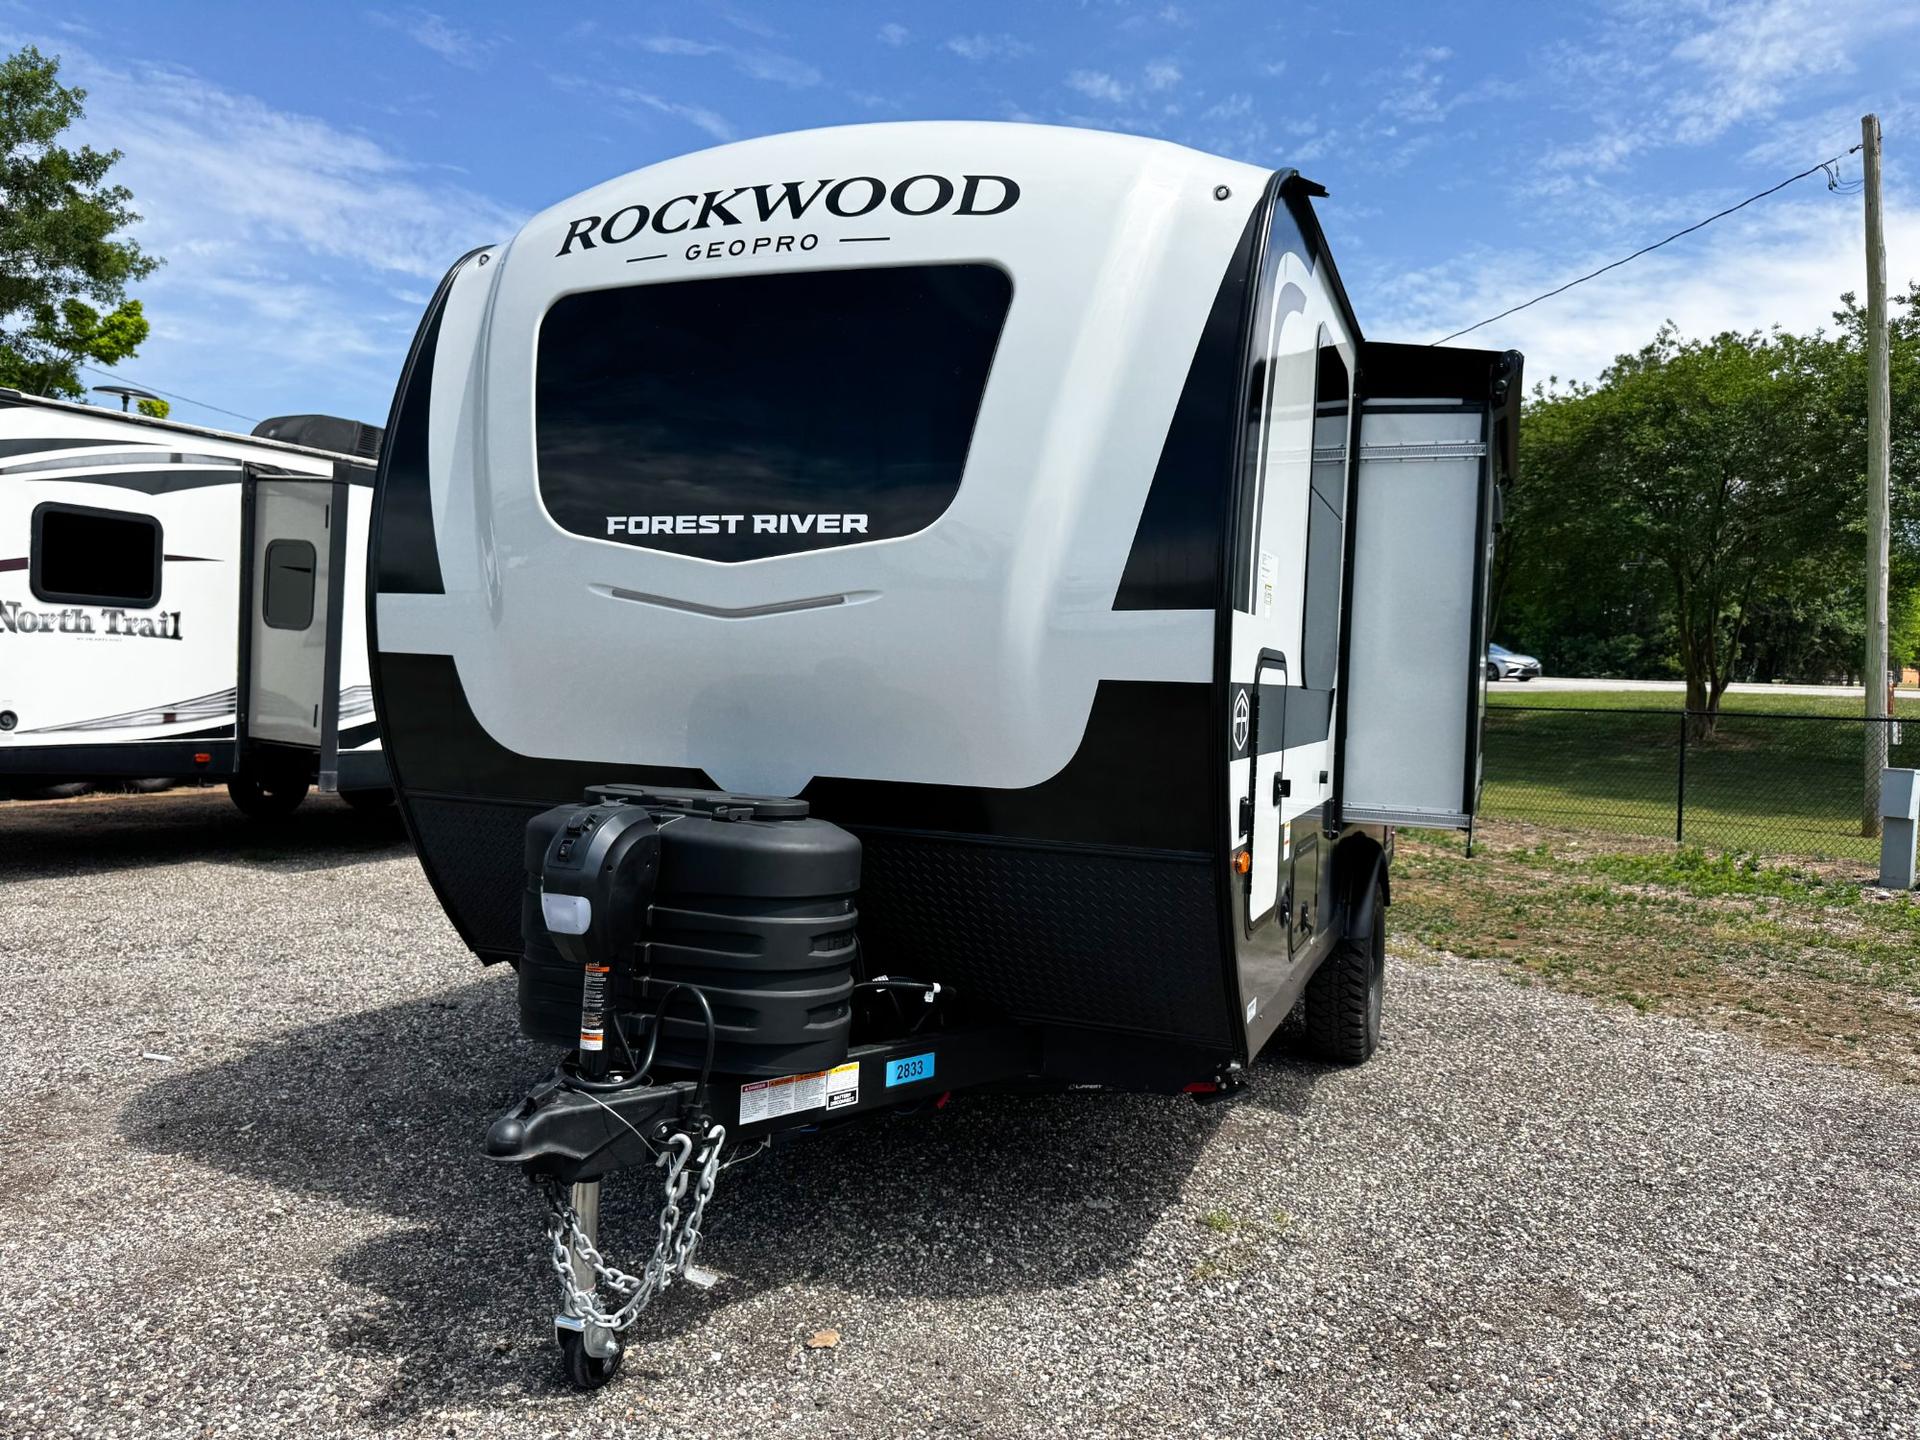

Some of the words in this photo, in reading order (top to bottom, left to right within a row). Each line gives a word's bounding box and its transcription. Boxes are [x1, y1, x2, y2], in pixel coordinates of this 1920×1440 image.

[555, 174, 1021, 257] ROCKWOOD
[685, 233, 819, 261] GEOPRO
[606, 515, 745, 535] FOREST
[752, 514, 869, 534] RIVER
[0, 600, 96, 634] North
[101, 608, 183, 641] Trail
[896, 1060, 924, 1080] 2833
